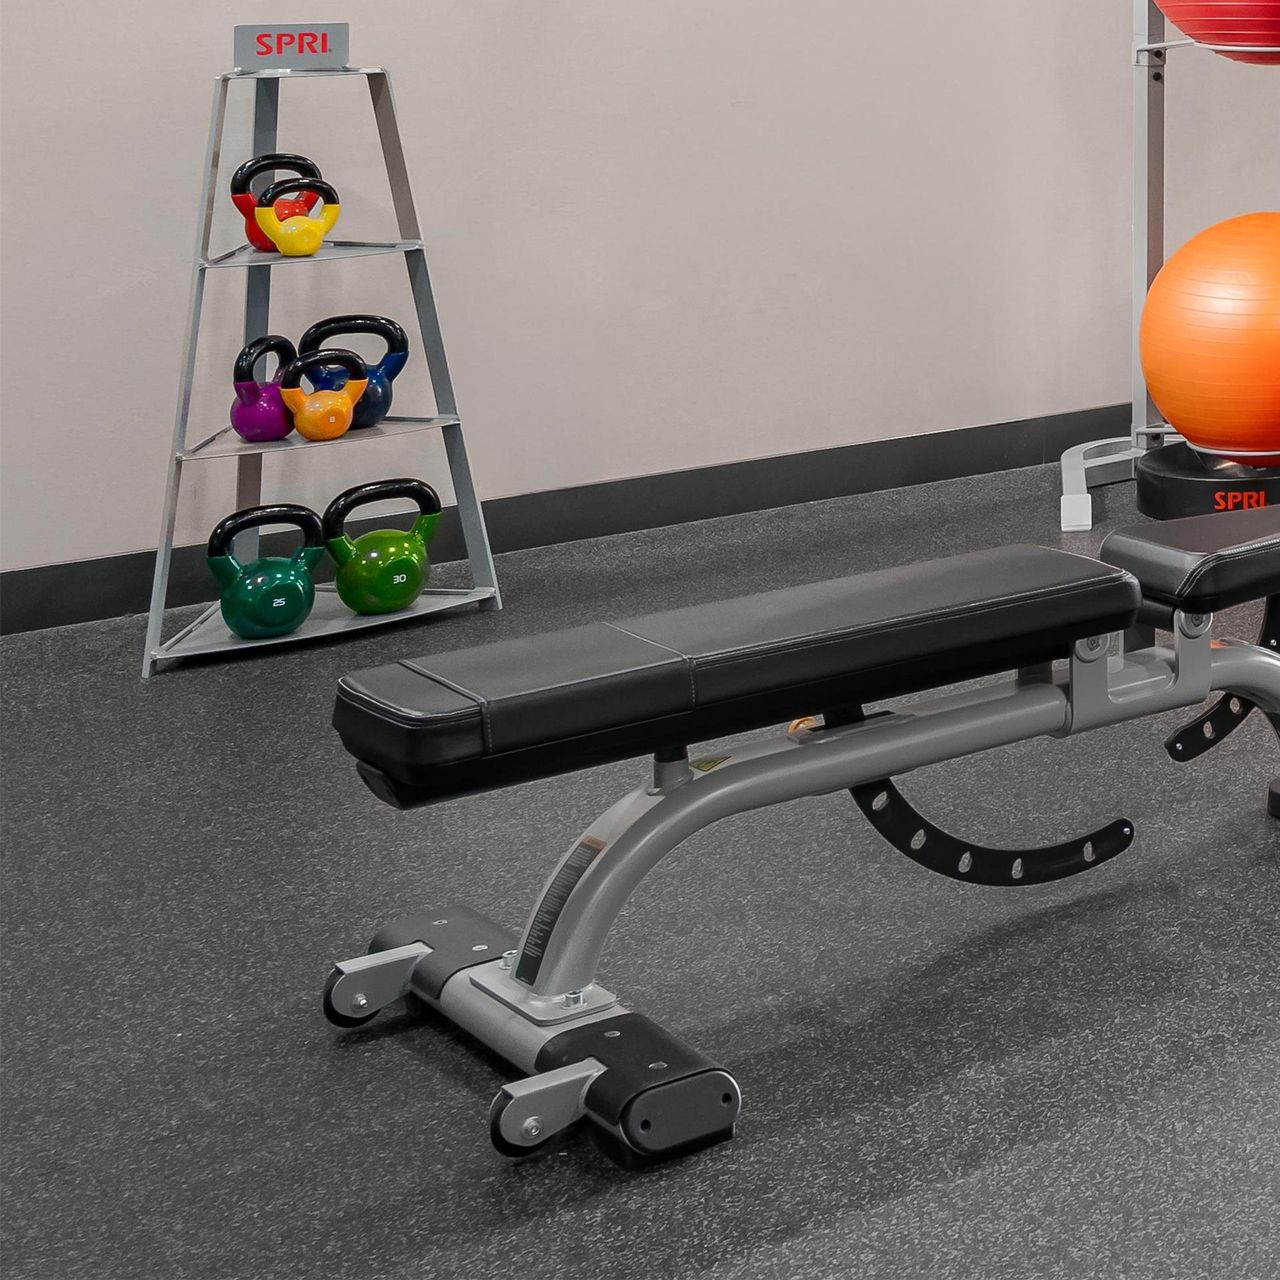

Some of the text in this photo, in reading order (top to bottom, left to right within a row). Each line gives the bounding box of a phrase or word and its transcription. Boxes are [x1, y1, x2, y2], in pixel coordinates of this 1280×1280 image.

[255, 32, 328, 56] SPRI
[1214, 490, 1265, 510] SPRI
[392, 574, 407, 584] 30
[272, 597, 286, 607] 25
